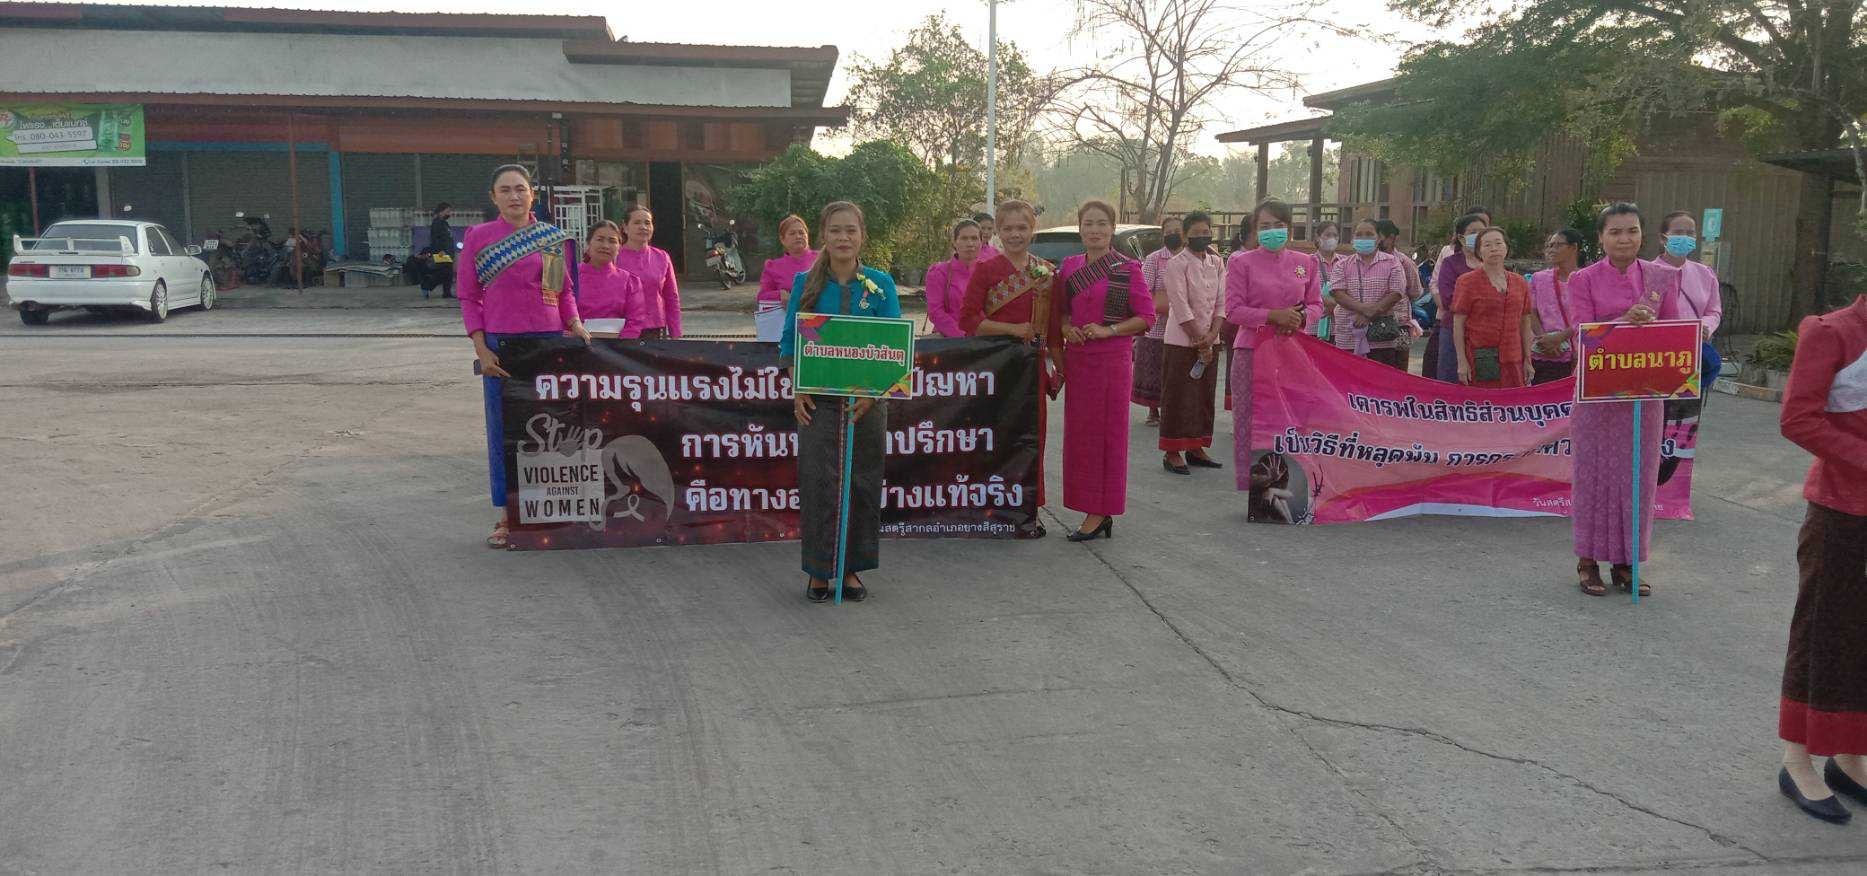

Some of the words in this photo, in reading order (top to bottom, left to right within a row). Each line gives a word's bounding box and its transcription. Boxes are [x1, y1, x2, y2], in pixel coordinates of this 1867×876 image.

[1589, 348, 1692, 374] ตำบลนาภู
[524, 464, 599, 484] VIOLENCE
[546, 486, 579, 498] AGAINST
[525, 498, 600, 518] WOMEN
